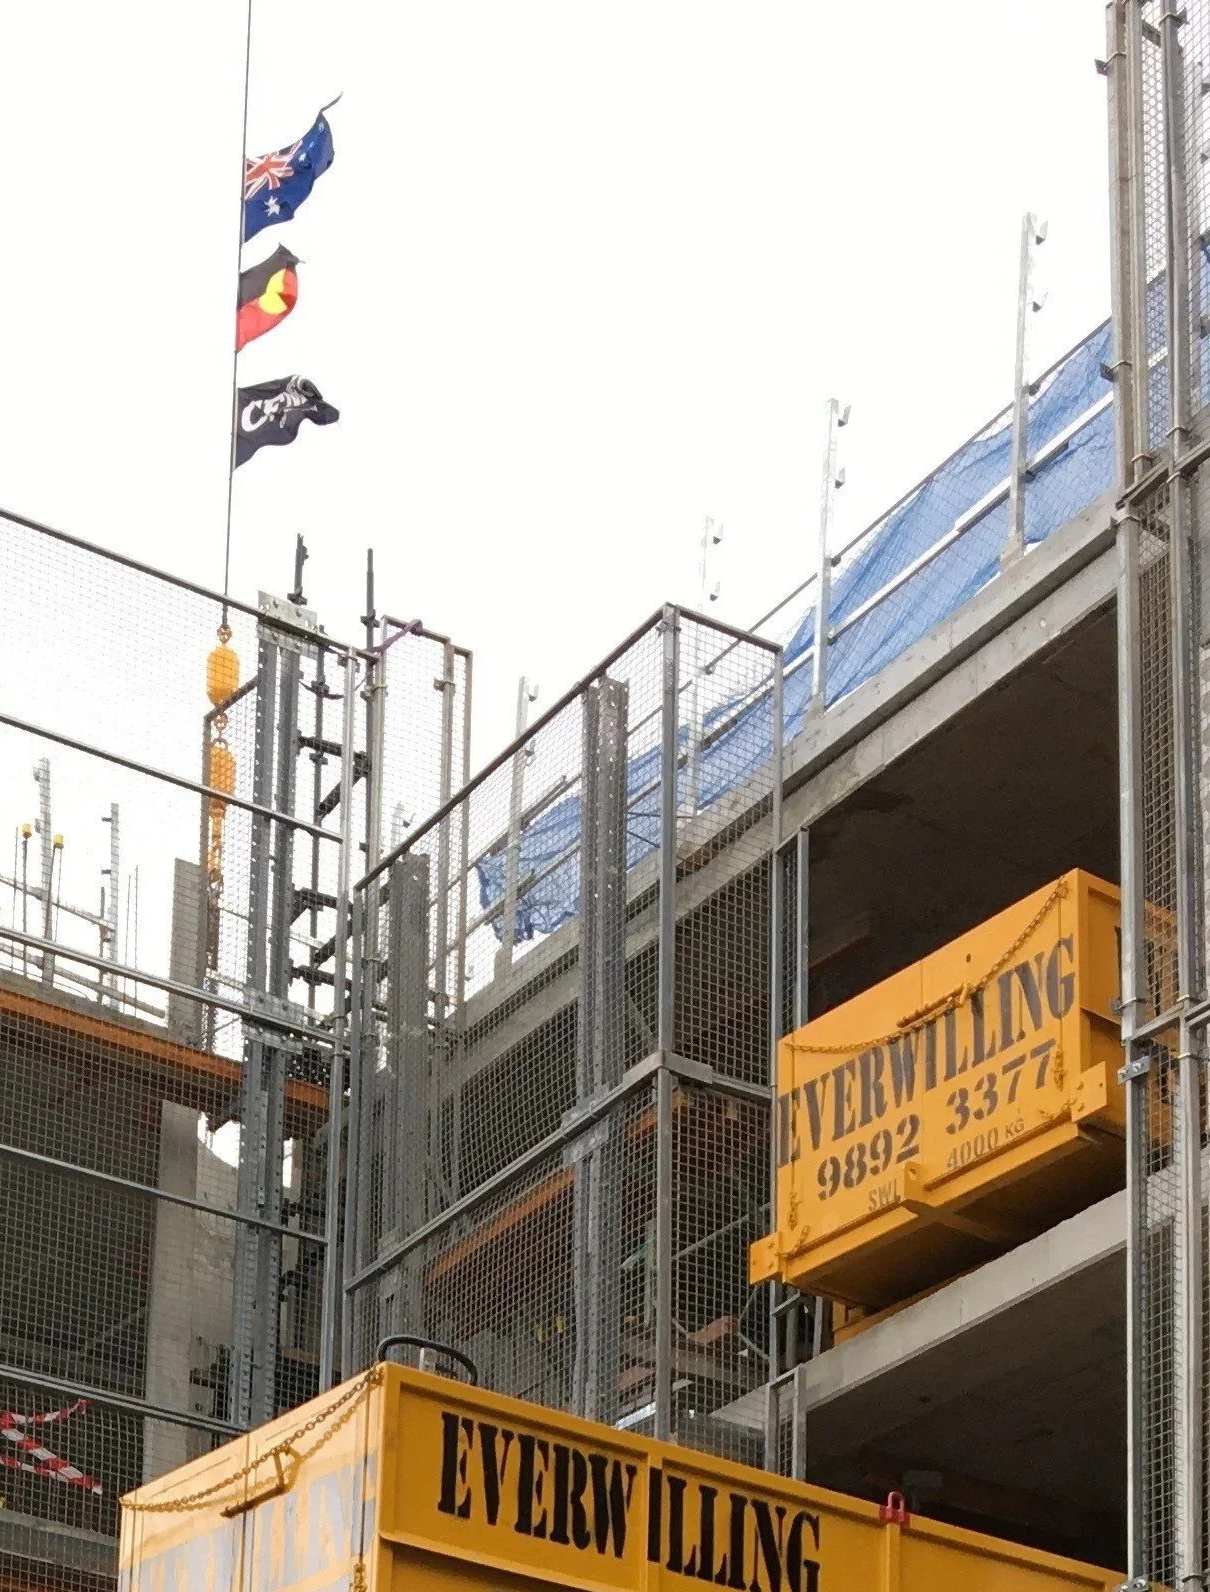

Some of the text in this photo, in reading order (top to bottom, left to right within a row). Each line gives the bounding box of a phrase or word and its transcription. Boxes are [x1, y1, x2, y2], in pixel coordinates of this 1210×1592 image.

[777, 935, 1076, 1168] EVERWILLING
[816, 1037, 1056, 1200] 9892 3377
[947, 1127, 999, 1171] 4000
[1004, 1118, 1025, 1139] KG
